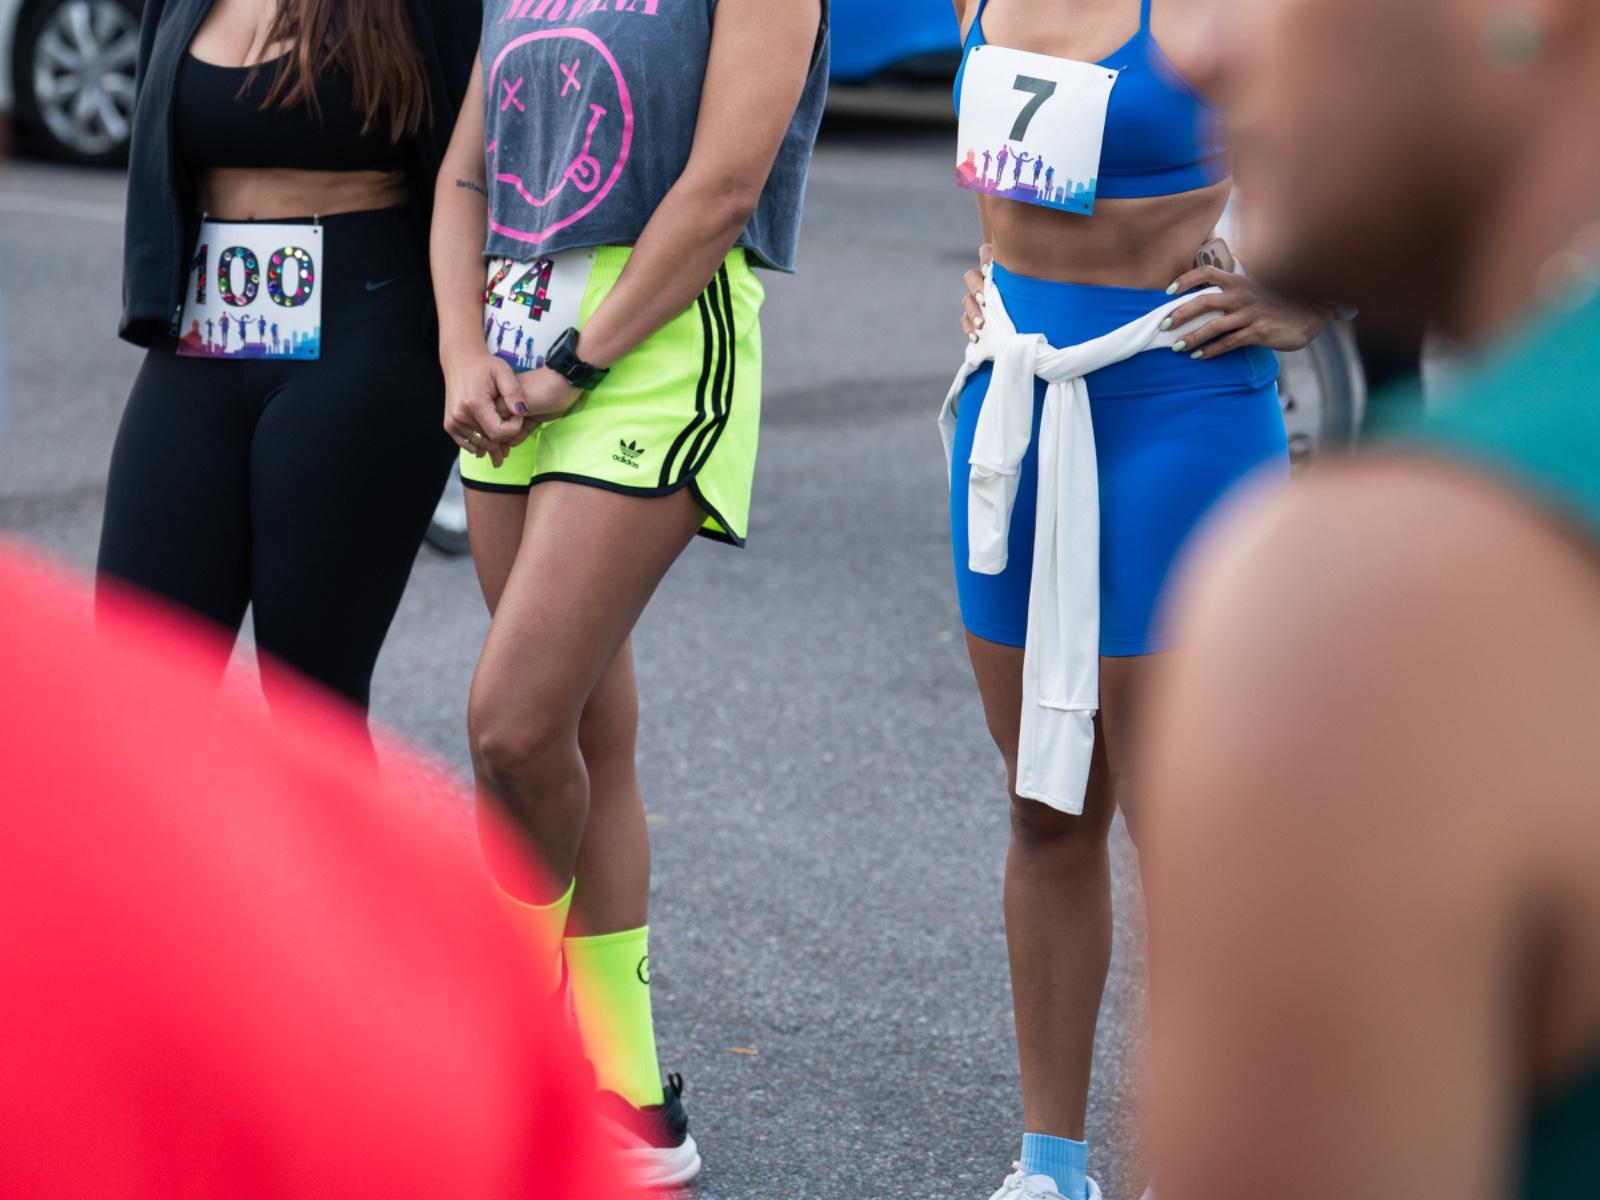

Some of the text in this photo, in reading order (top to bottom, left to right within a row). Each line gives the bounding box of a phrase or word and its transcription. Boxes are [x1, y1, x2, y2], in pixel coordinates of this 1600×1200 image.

[1009, 74, 1058, 142] 7
[192, 244, 315, 308] 100
[612, 454, 639, 469] adidas
